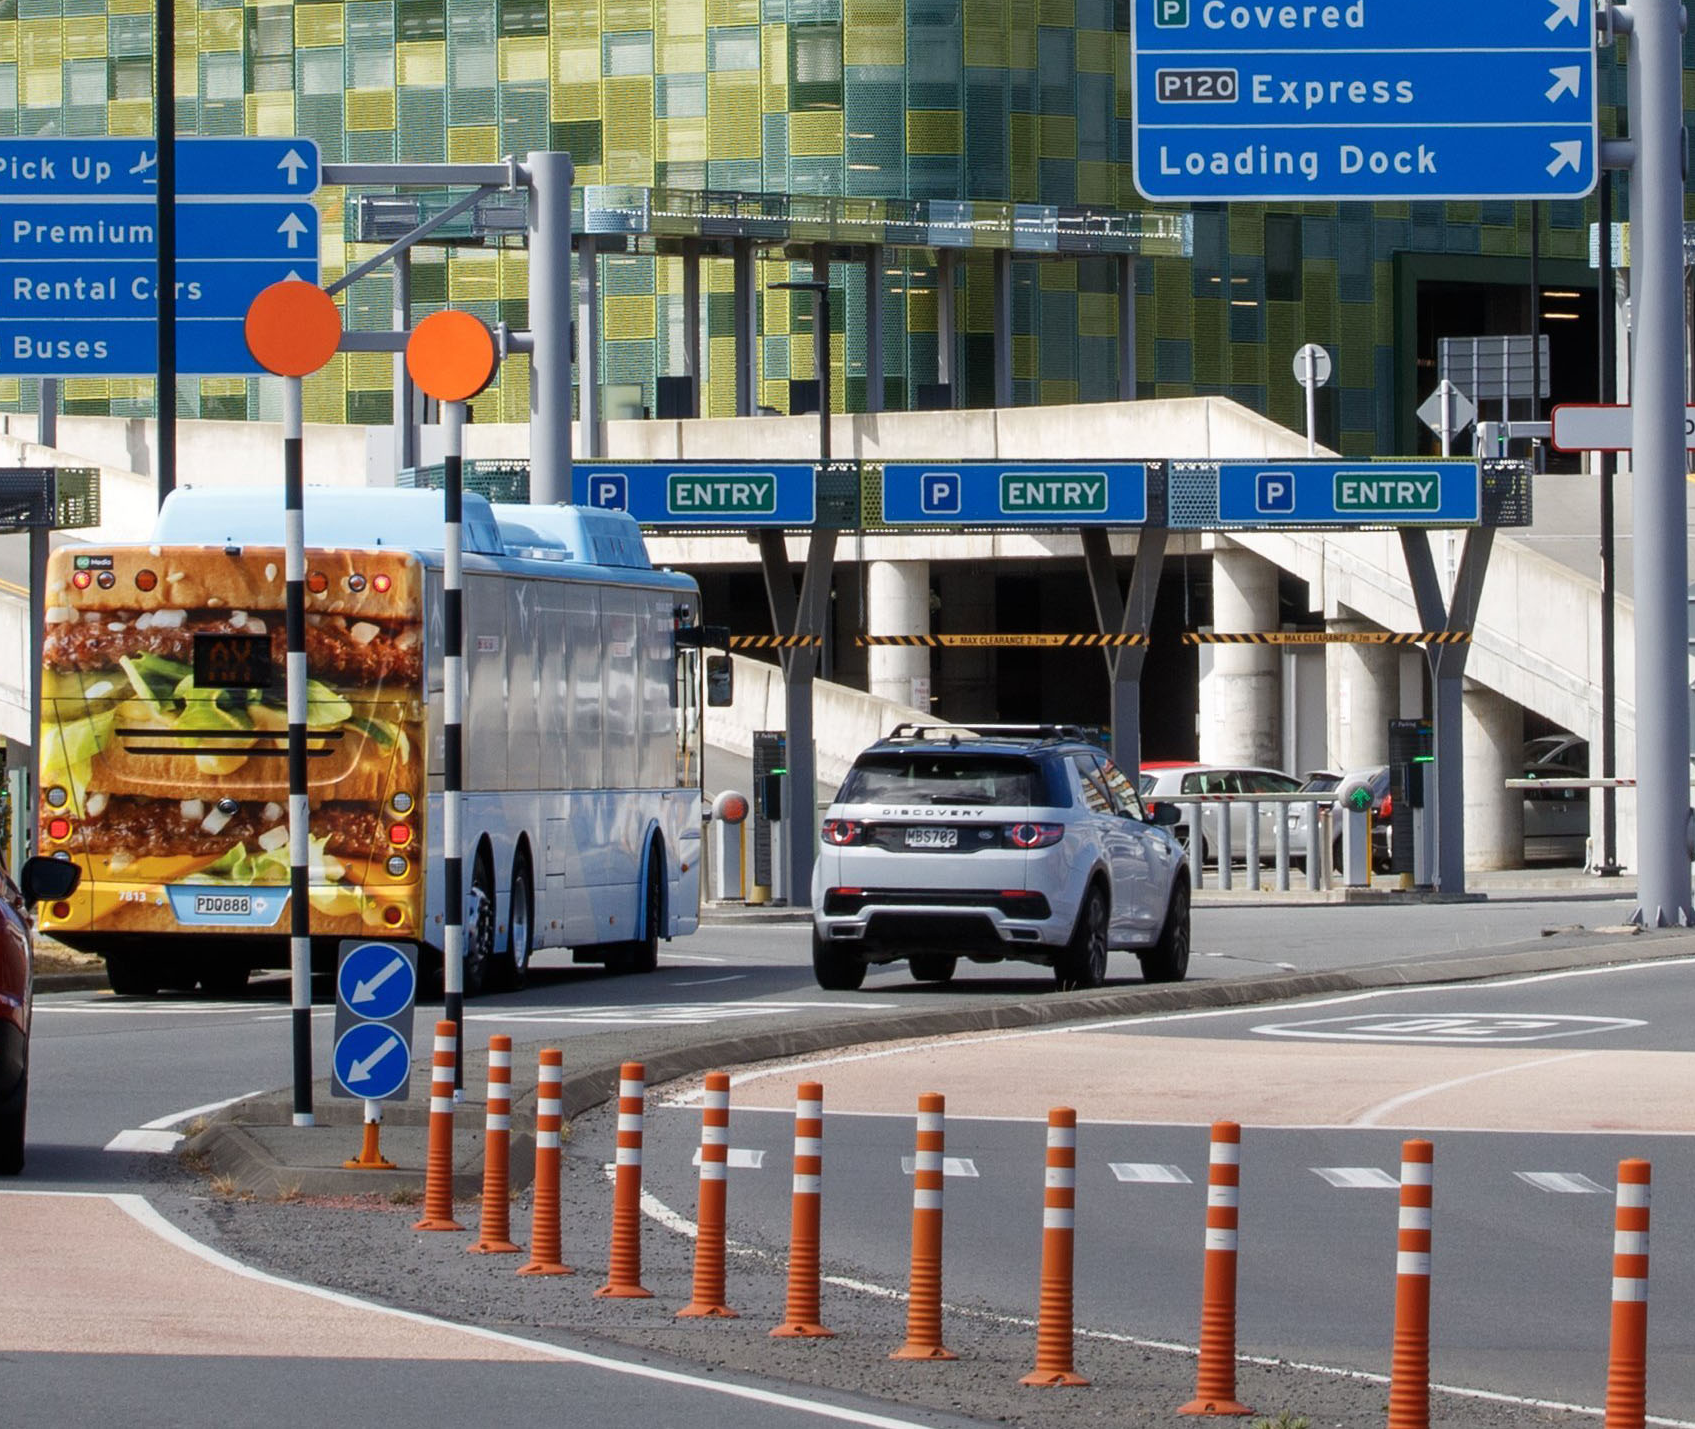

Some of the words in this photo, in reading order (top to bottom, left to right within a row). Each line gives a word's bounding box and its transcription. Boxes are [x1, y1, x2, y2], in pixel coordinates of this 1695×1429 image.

[1163, 1, 1180, 20] P
[1164, 76, 1234, 97] P120
[1252, 74, 1414, 110] Express
[71, 156, 112, 184] Up
[1160, 145, 1318, 181] Loading
[1340, 144, 1437, 174] Dock
[13, 220, 154, 244] Premium
[13, 276, 116, 301] Rental
[131, 276, 203, 301] Crs
[13, 335, 109, 359] Buses
[599, 483, 617, 506] P
[675, 482, 768, 507] ENTRY
[931, 482, 951, 506] P
[1008, 481, 1101, 506] ENTRY
[1266, 481, 1285, 505] P
[1341, 481, 1435, 505] ENTRY
[960, 636, 977, 644] MAX
[979, 636, 1025, 645] CLEARANCE
[1283, 634, 1302, 642] MAX
[1304, 634, 1348, 642] CLEARANCE
[882, 808, 984, 818] DISCOVERY
[907, 830, 956, 843] MBS702
[118, 891, 147, 902] 7813
[197, 897, 249, 912] PDQ888
